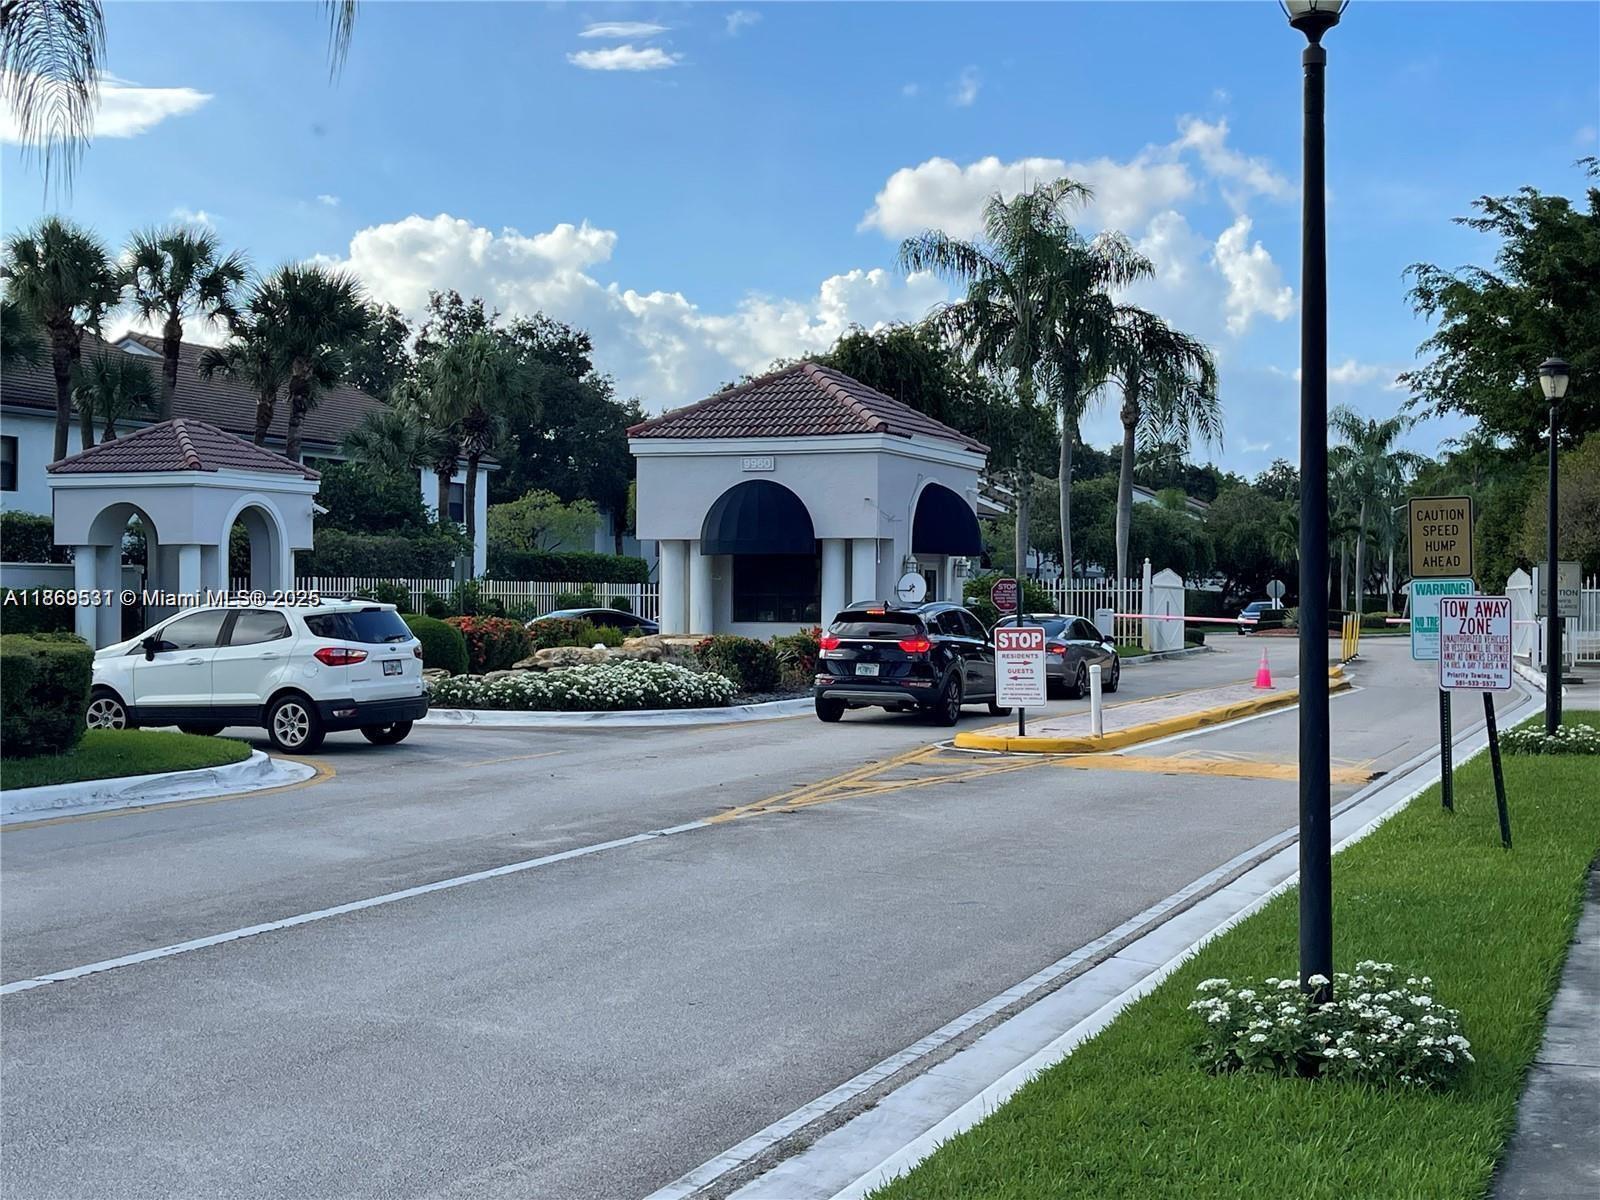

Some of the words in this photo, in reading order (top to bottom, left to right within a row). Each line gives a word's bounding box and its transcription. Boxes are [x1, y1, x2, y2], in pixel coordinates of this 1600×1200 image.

[1416, 508, 1465, 522] CAUTION
[1422, 524, 1459, 537] SPEED
[1425, 540, 1456, 552] HUMP
[1422, 555, 1461, 568] AHEAD
[1415, 583, 1469, 595] WARNING!
[1540, 589, 1579, 597] CTION
[1443, 601, 1469, 618] TOW
[1475, 601, 1509, 618] AWAY
[1459, 618, 1493, 635] ZONE
[998, 632, 1042, 648] STOP
[1484, 635, 1509, 644] VEHICLES
[1451, 643, 1471, 652] VESSELS
[1487, 653, 1509, 662] EXPENSE
[1444, 661, 1450, 669] 24
[1447, 672, 1468, 680] Priority
